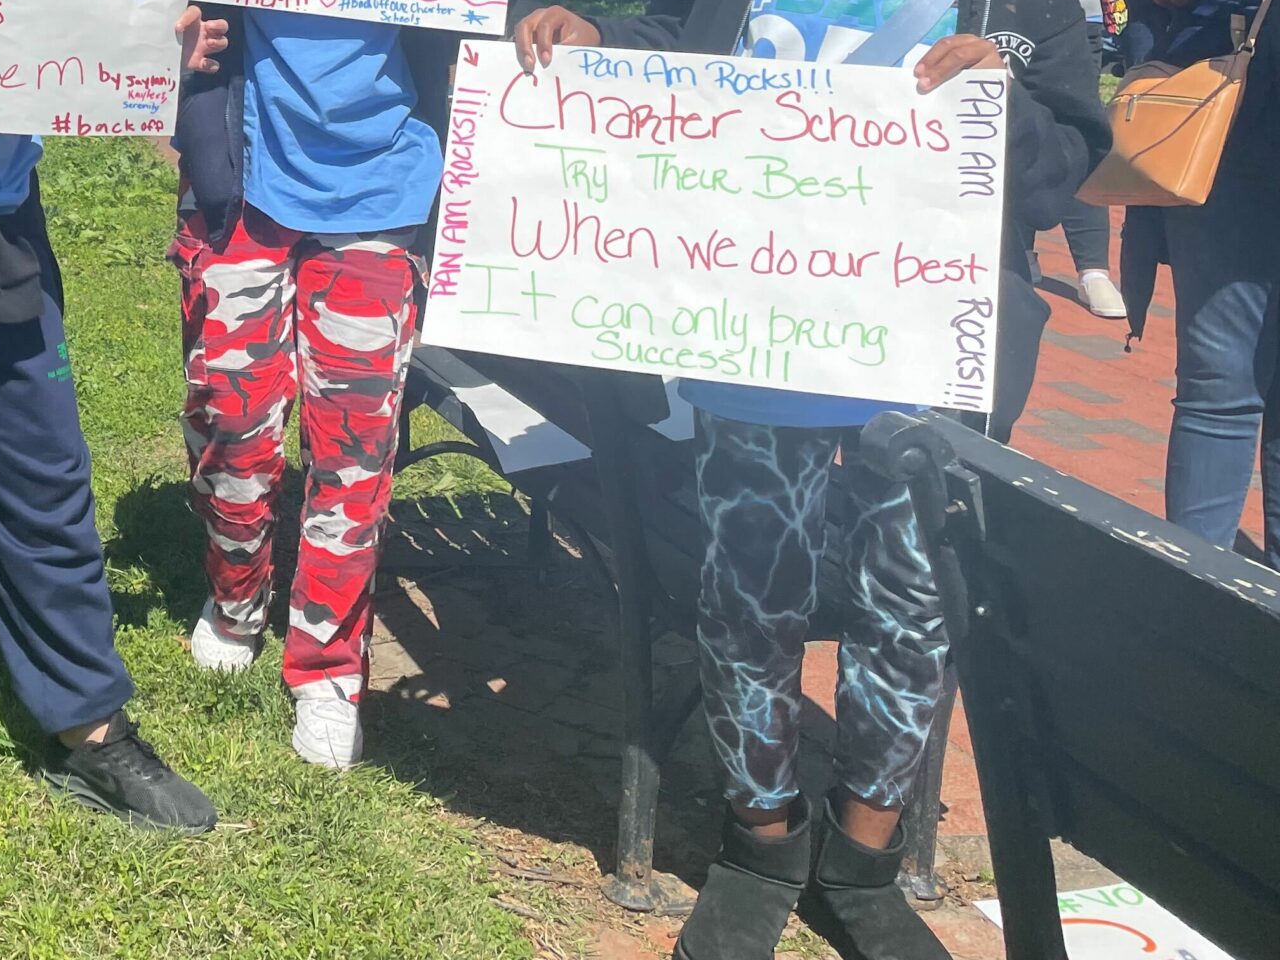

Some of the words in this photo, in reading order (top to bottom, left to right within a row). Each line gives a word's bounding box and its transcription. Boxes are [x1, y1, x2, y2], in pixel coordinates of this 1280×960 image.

[98, 62, 120, 91] by
[568, 48, 634, 78] Pan
[643, 54, 697, 88] Am
[705, 60, 834, 96] Rocks!!!
[760, 90, 951, 153] Schools
[744, 155, 874, 207] Best
[511, 196, 660, 269] When
[750, 230, 798, 276] do
[808, 248, 881, 278] our
[894, 241, 989, 289] best
[460, 262, 557, 322] It
[671, 297, 749, 355] only
